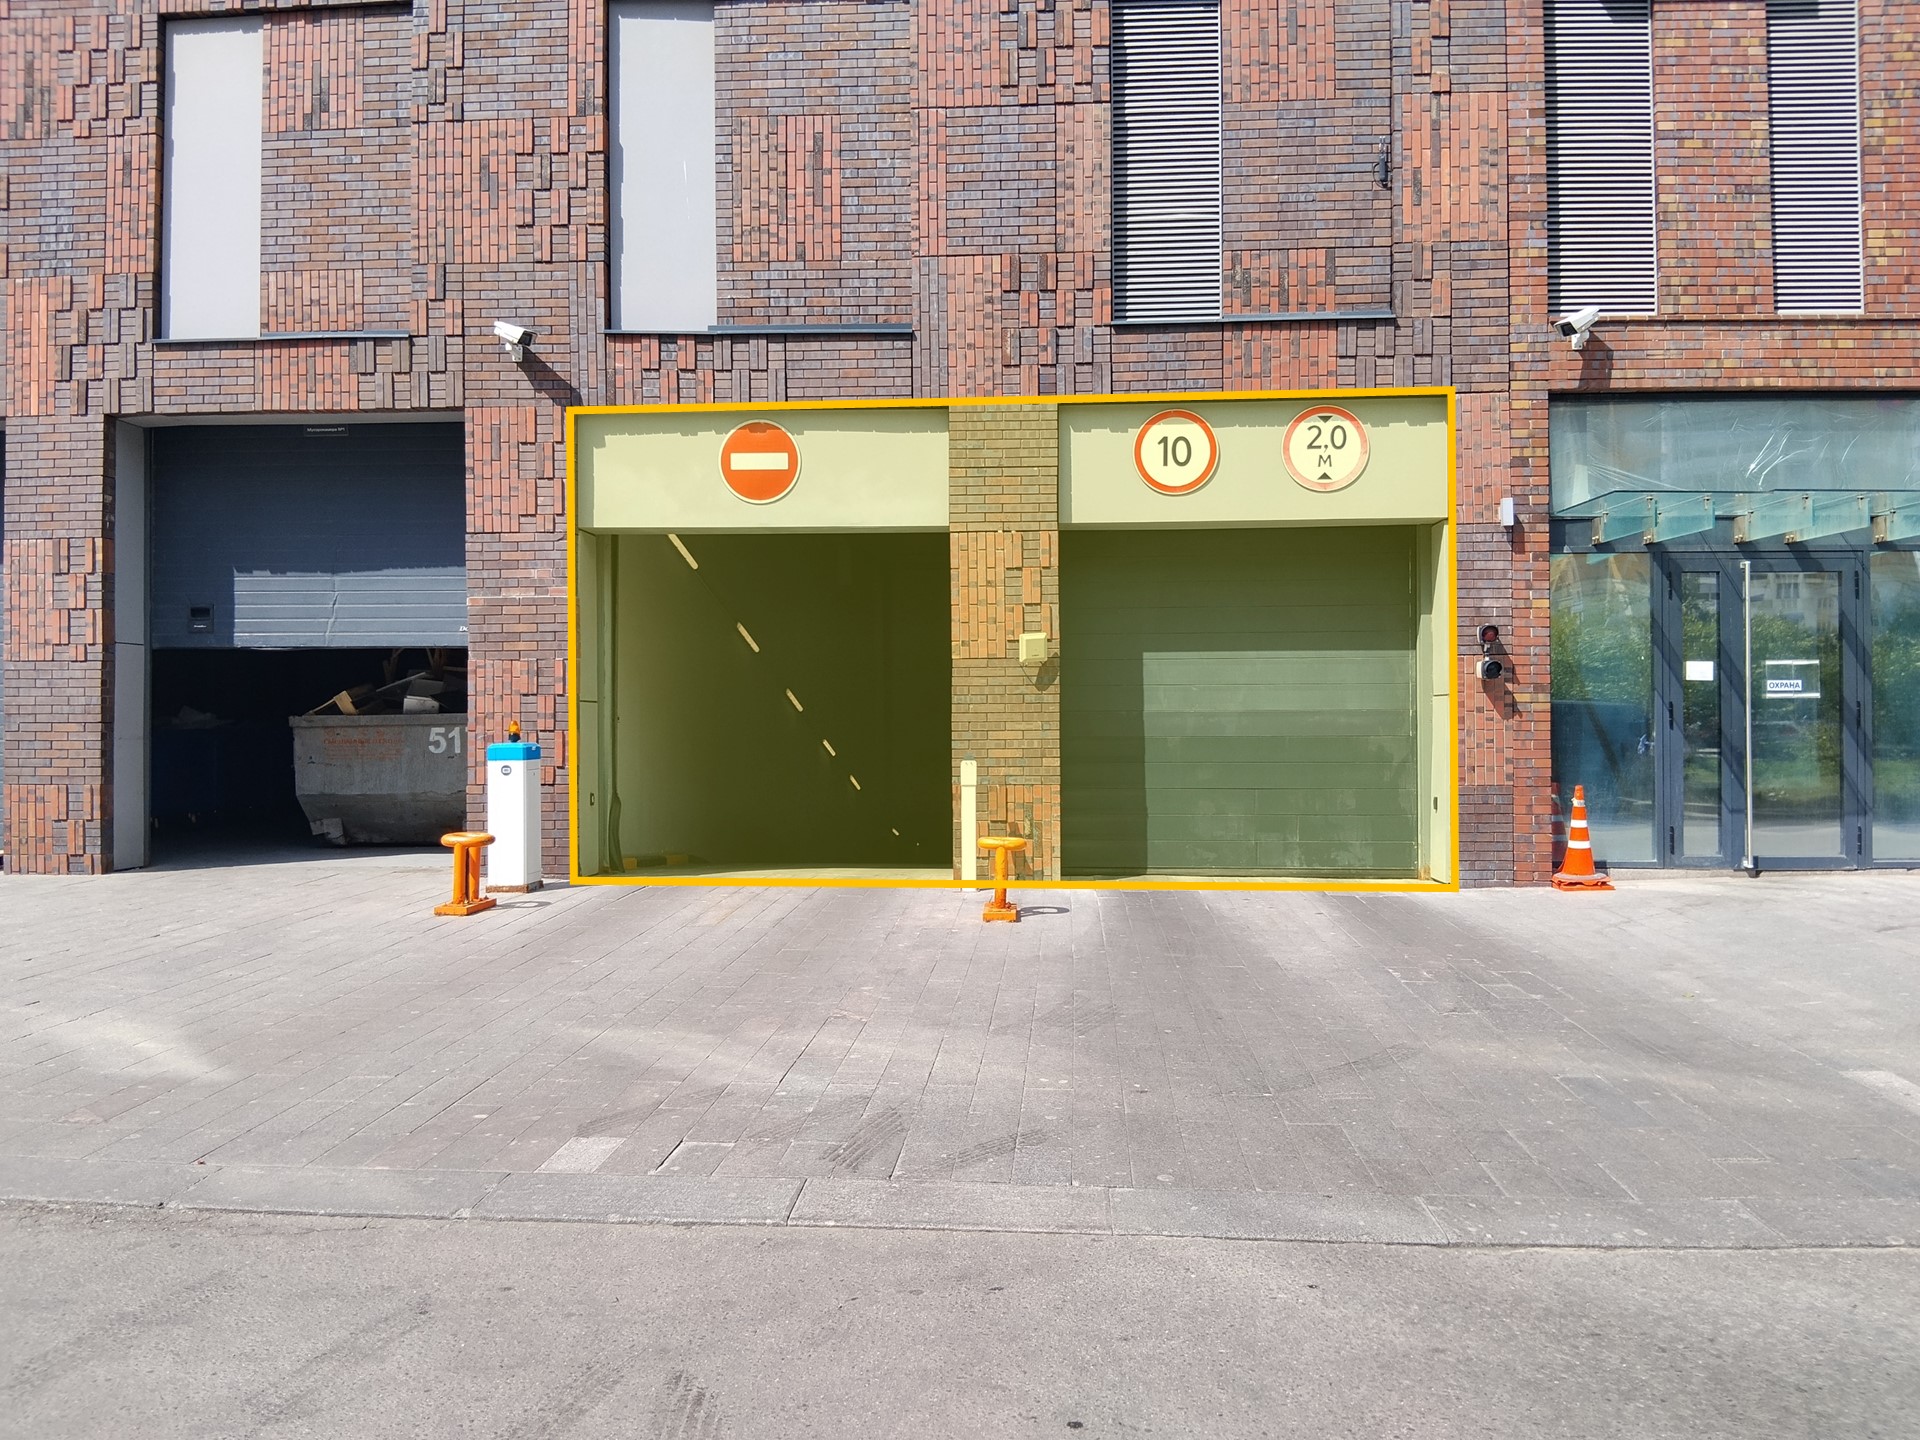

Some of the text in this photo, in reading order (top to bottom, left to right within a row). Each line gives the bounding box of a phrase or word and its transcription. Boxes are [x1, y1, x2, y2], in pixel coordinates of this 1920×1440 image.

[1157, 435, 1193, 467] 10
[1306, 424, 1347, 453] 2,0
[1768, 681, 1801, 689] ОХРАНА
[428, 726, 468, 754] 51
